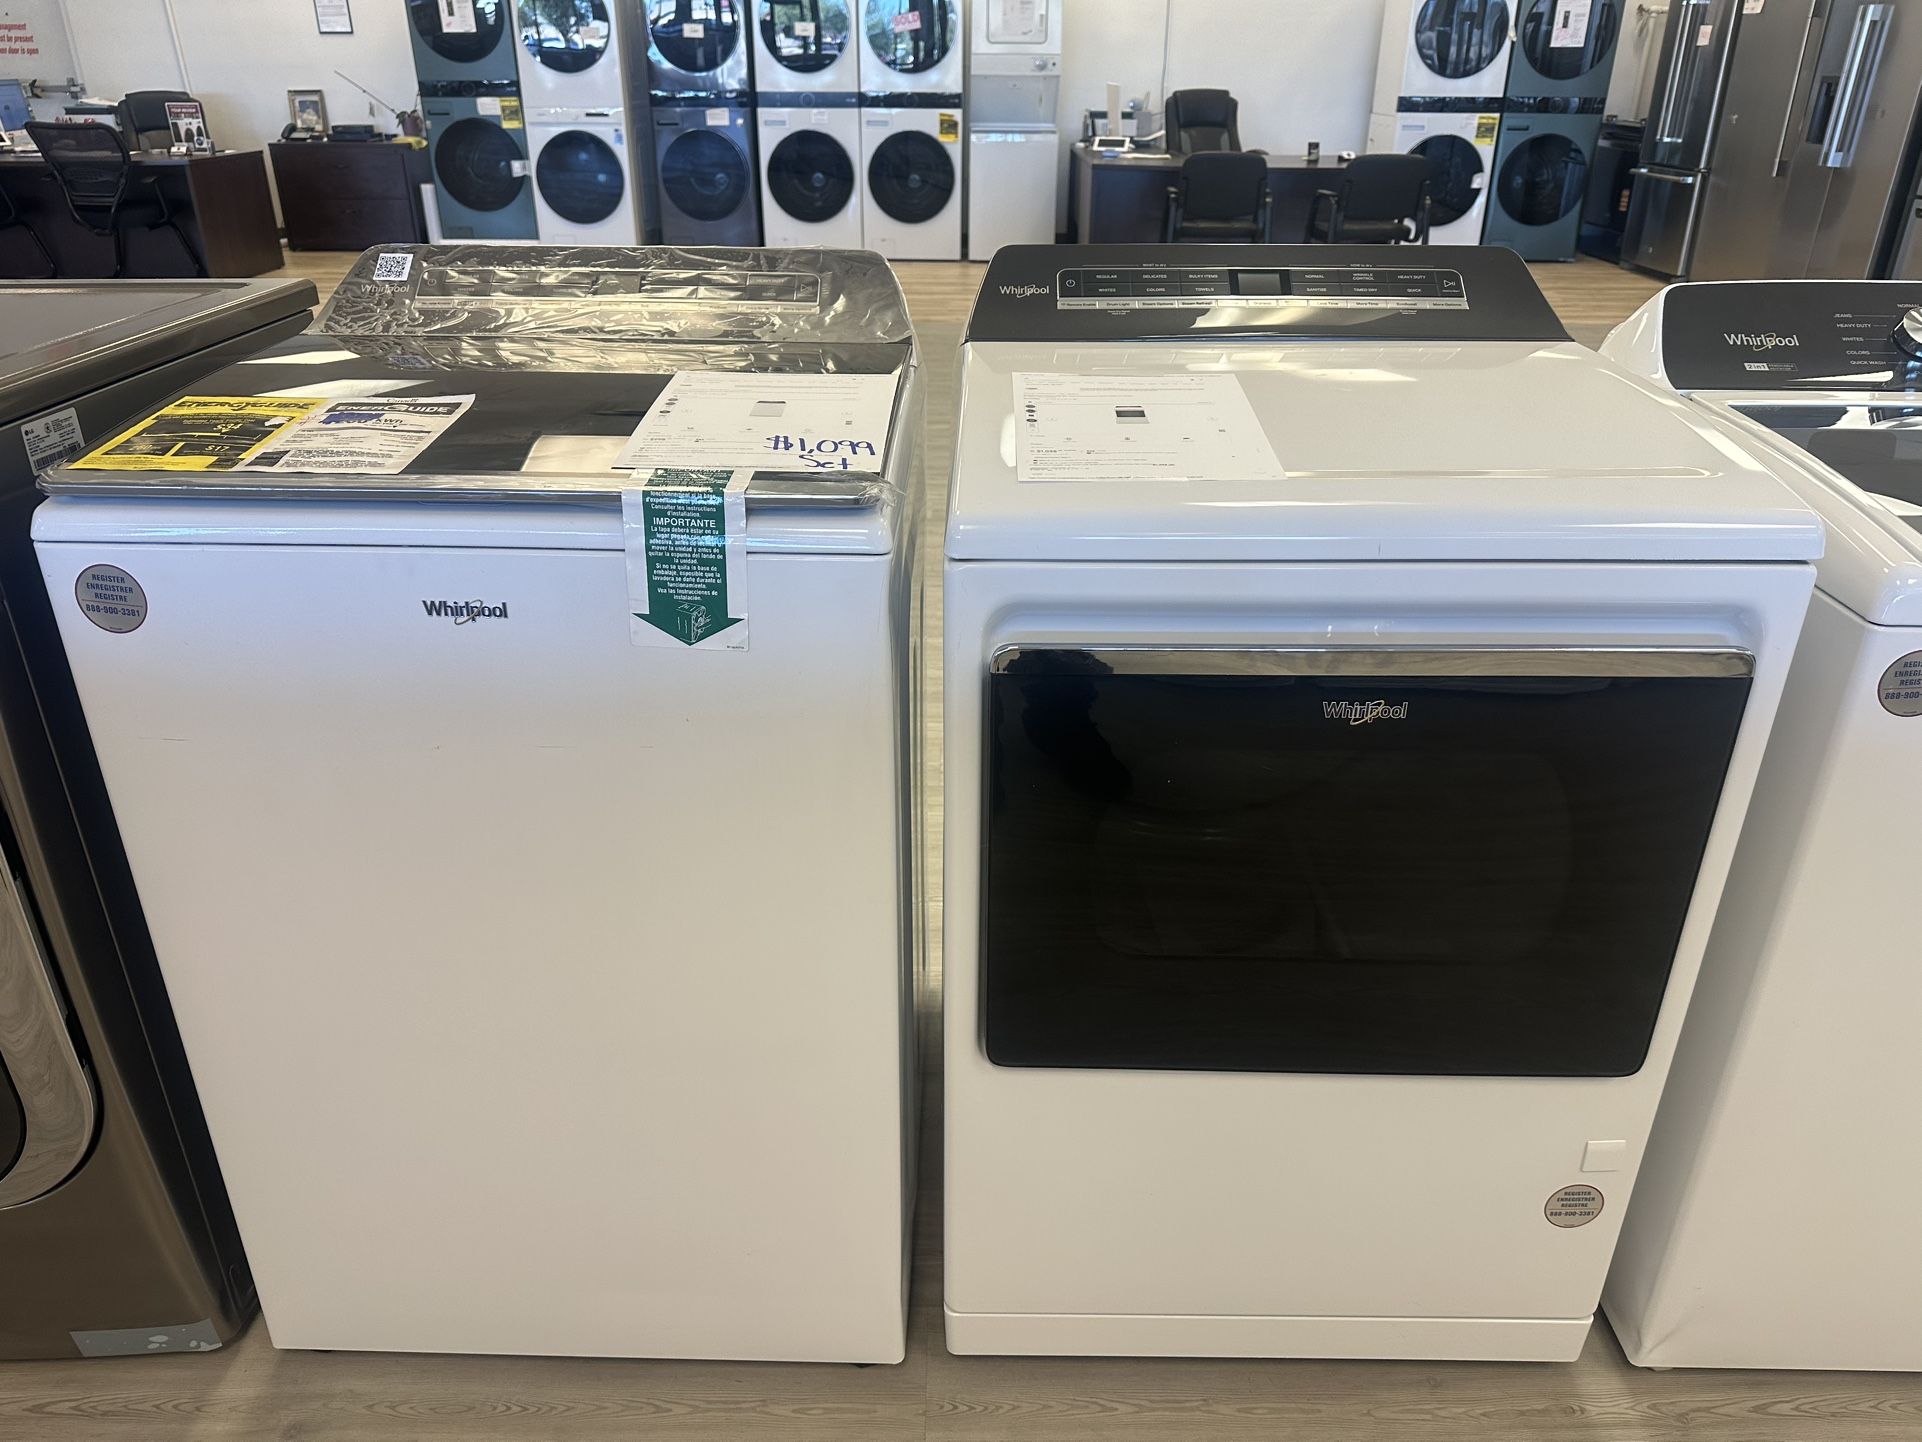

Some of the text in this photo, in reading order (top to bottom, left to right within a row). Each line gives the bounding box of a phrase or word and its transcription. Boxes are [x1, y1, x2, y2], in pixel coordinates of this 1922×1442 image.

[14, 36, 33, 44] present
[8, 46, 19, 54] door
[27, 47, 39, 55] open
[361, 284, 410, 295] Whirlpool
[1000, 284, 1049, 298] Whirlpool
[1724, 333, 1799, 351] Whirlpool
[205, 444, 229, 452] $17
[764, 435, 876, 456] $1,099
[799, 454, 853, 470] Set
[653, 517, 716, 528] IMPORTANTE
[92, 574, 125, 583] REGISTER
[86, 582, 133, 594] ENREGISTRER
[94, 592, 128, 602] REGISTRE
[86, 604, 140, 616] 888-900-3381
[422, 600, 509, 624] Whirlpool
[1895, 670, 1922, 678] ENREGI
[1323, 700, 1408, 724] Whirlpool
